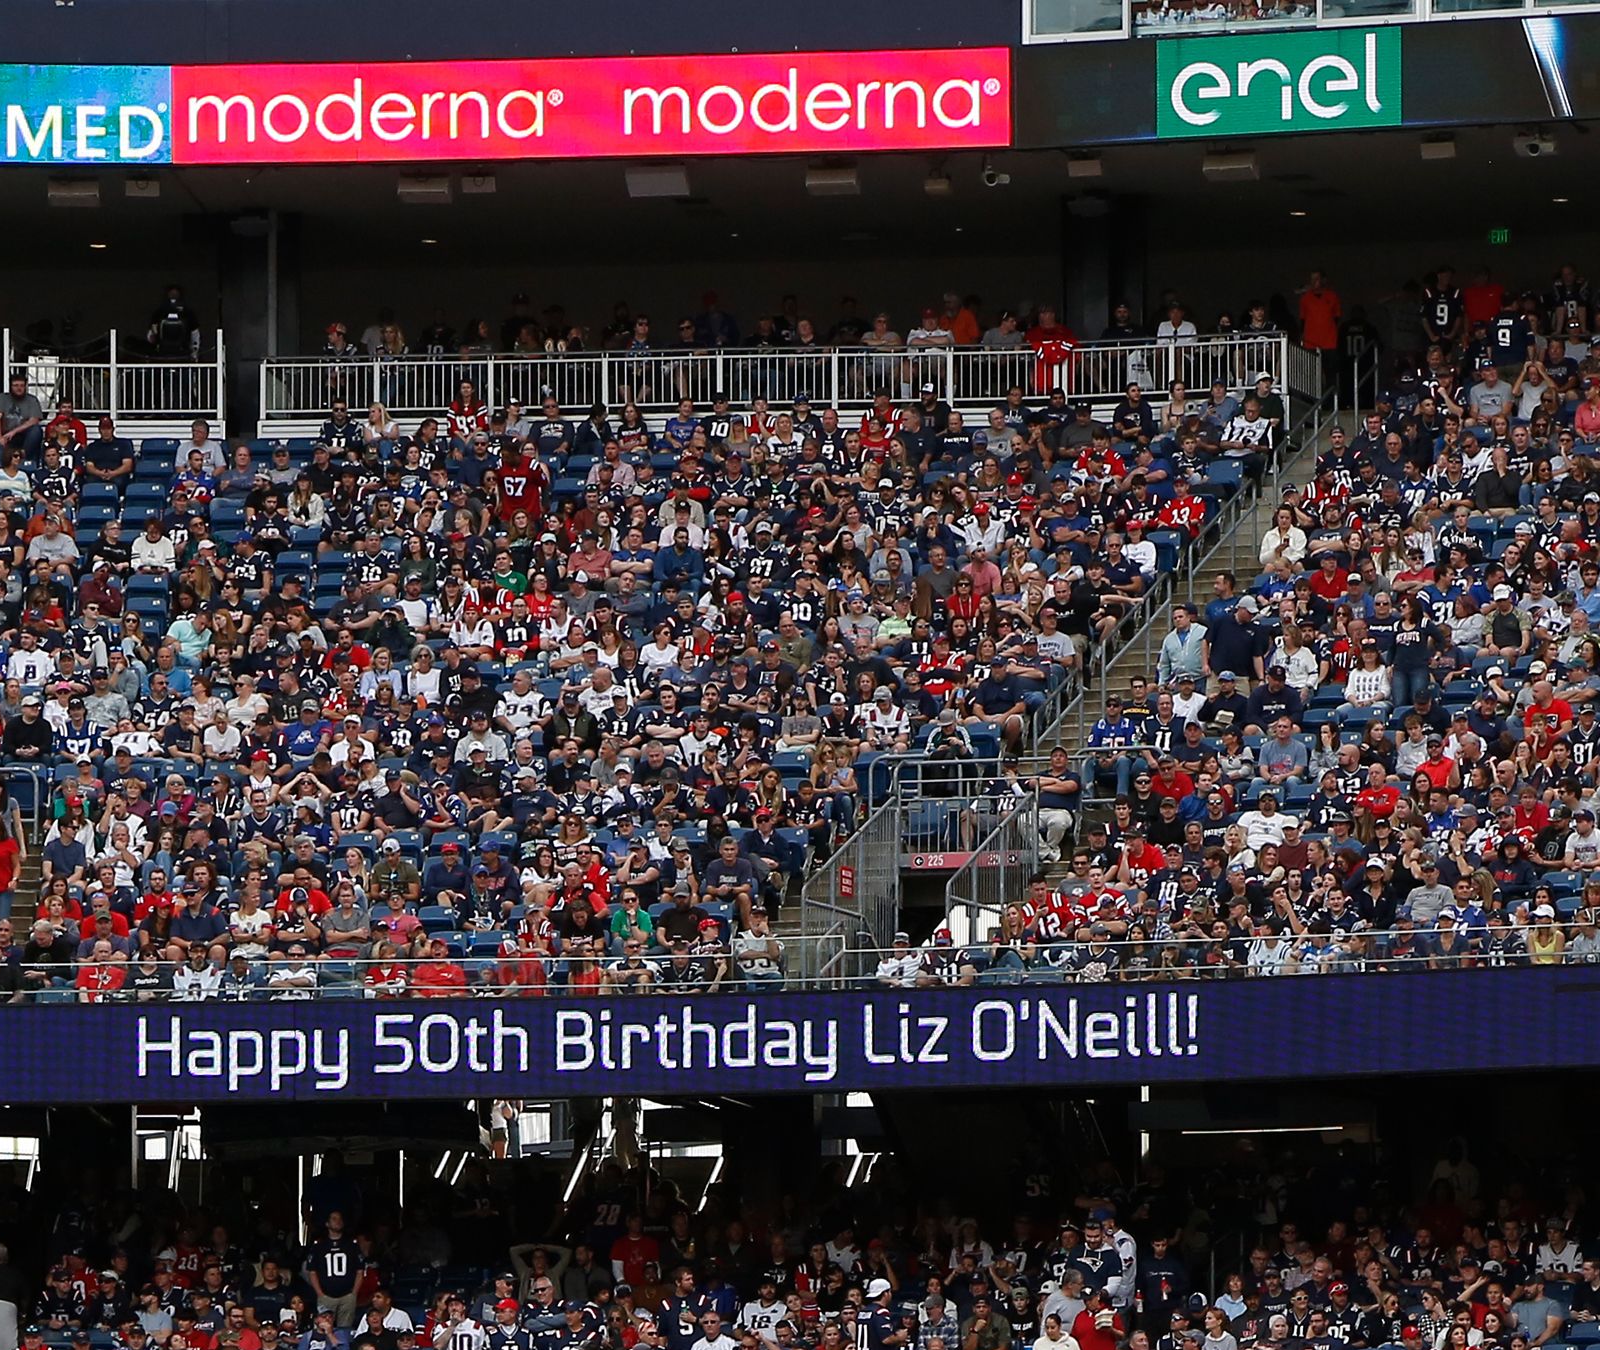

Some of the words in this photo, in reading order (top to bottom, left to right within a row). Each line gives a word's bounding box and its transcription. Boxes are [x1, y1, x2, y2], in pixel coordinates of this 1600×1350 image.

[1171, 33, 1381, 125] enel
[1436, 304, 1448, 325] 9
[1498, 329, 1510, 346] 9
[504, 477, 526, 496] 67
[790, 603, 811, 621] 10
[1432, 602, 1455, 625] 31
[1155, 731, 1171, 748] 11
[1574, 742, 1595, 767] 87
[928, 855, 943, 866] 225
[1038, 913, 1060, 937] 12
[139, 1017, 348, 1090] Happy
[375, 1010, 527, 1073] 50th
[557, 1005, 836, 1081] Birthday
[865, 1003, 948, 1063] Liz
[973, 993, 1197, 1060] O'Neill!
[325, 1253, 346, 1276] 10
[858, 1329, 869, 1350] 11
